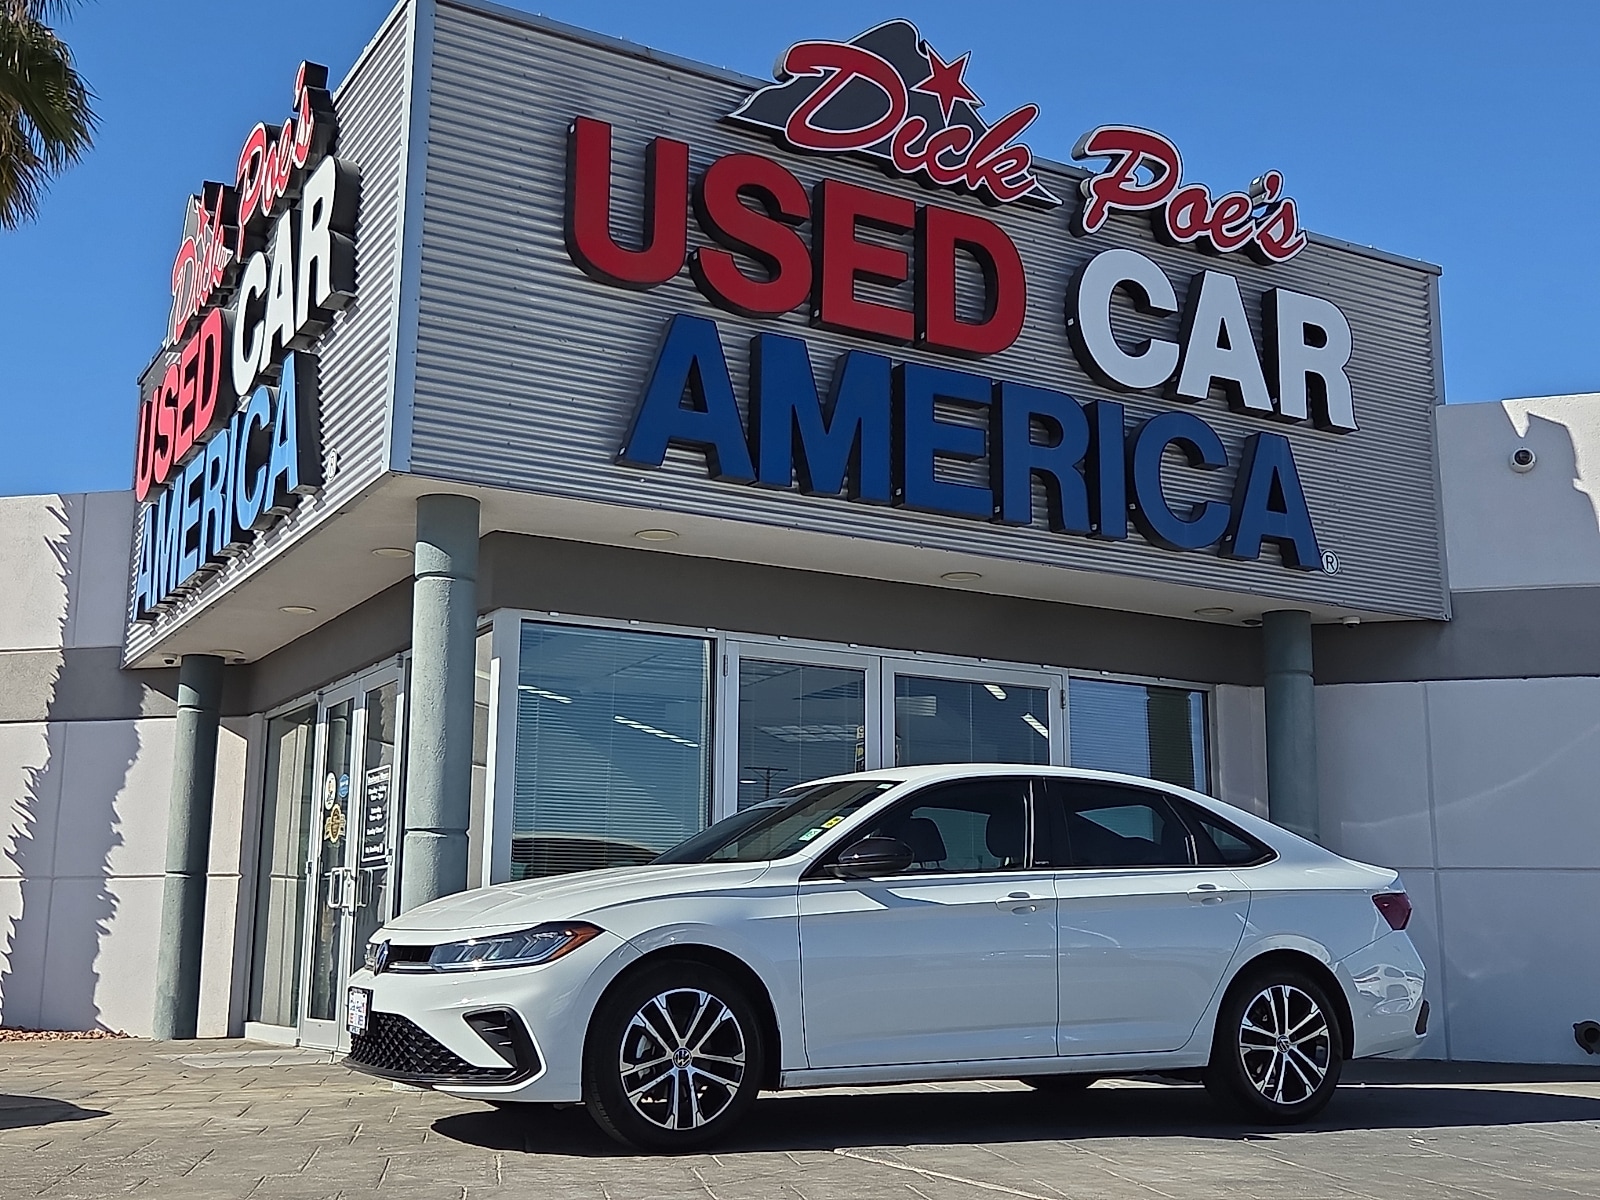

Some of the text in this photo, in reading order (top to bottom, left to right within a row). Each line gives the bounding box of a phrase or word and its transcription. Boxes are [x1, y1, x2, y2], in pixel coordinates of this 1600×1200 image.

[171, 59, 315, 346] Dick Poe's
[568, 115, 1359, 431] USED CAR
[782, 40, 1308, 263] Dick Poe's
[134, 154, 336, 502] USED CAR
[621, 313, 1321, 571] AMERICA
[131, 351, 299, 623] AMERICA
